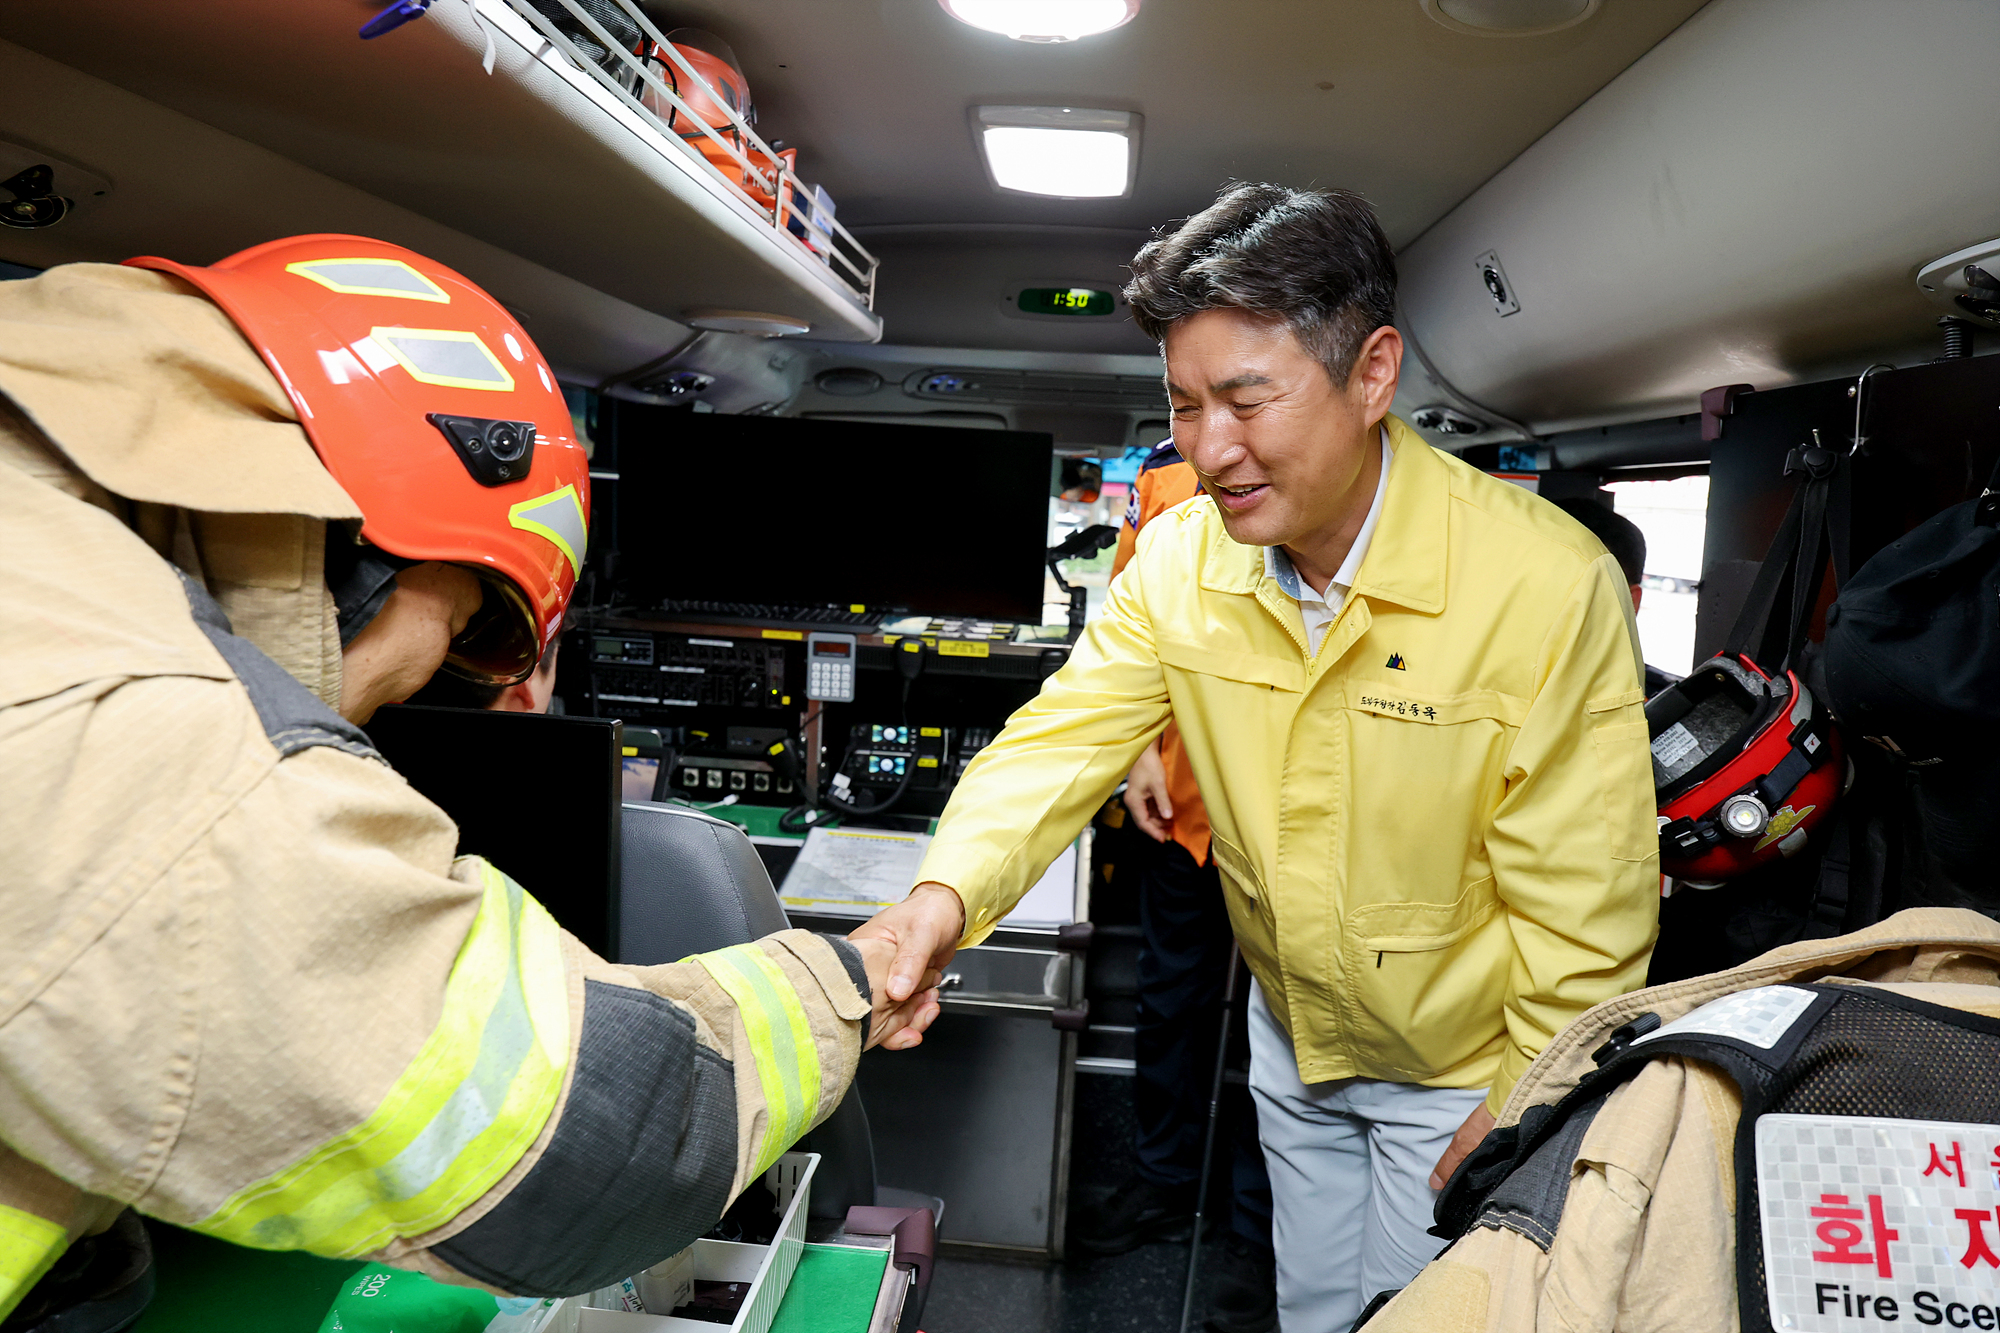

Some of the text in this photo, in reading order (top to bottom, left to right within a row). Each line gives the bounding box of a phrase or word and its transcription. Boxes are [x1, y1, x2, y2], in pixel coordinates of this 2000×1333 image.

[1053, 292, 1090, 308] 1:50
[351, 1274, 373, 1296] WIPES
[362, 1273, 392, 1298] 200
[1815, 1283, 2000, 1331] Fire Sce
